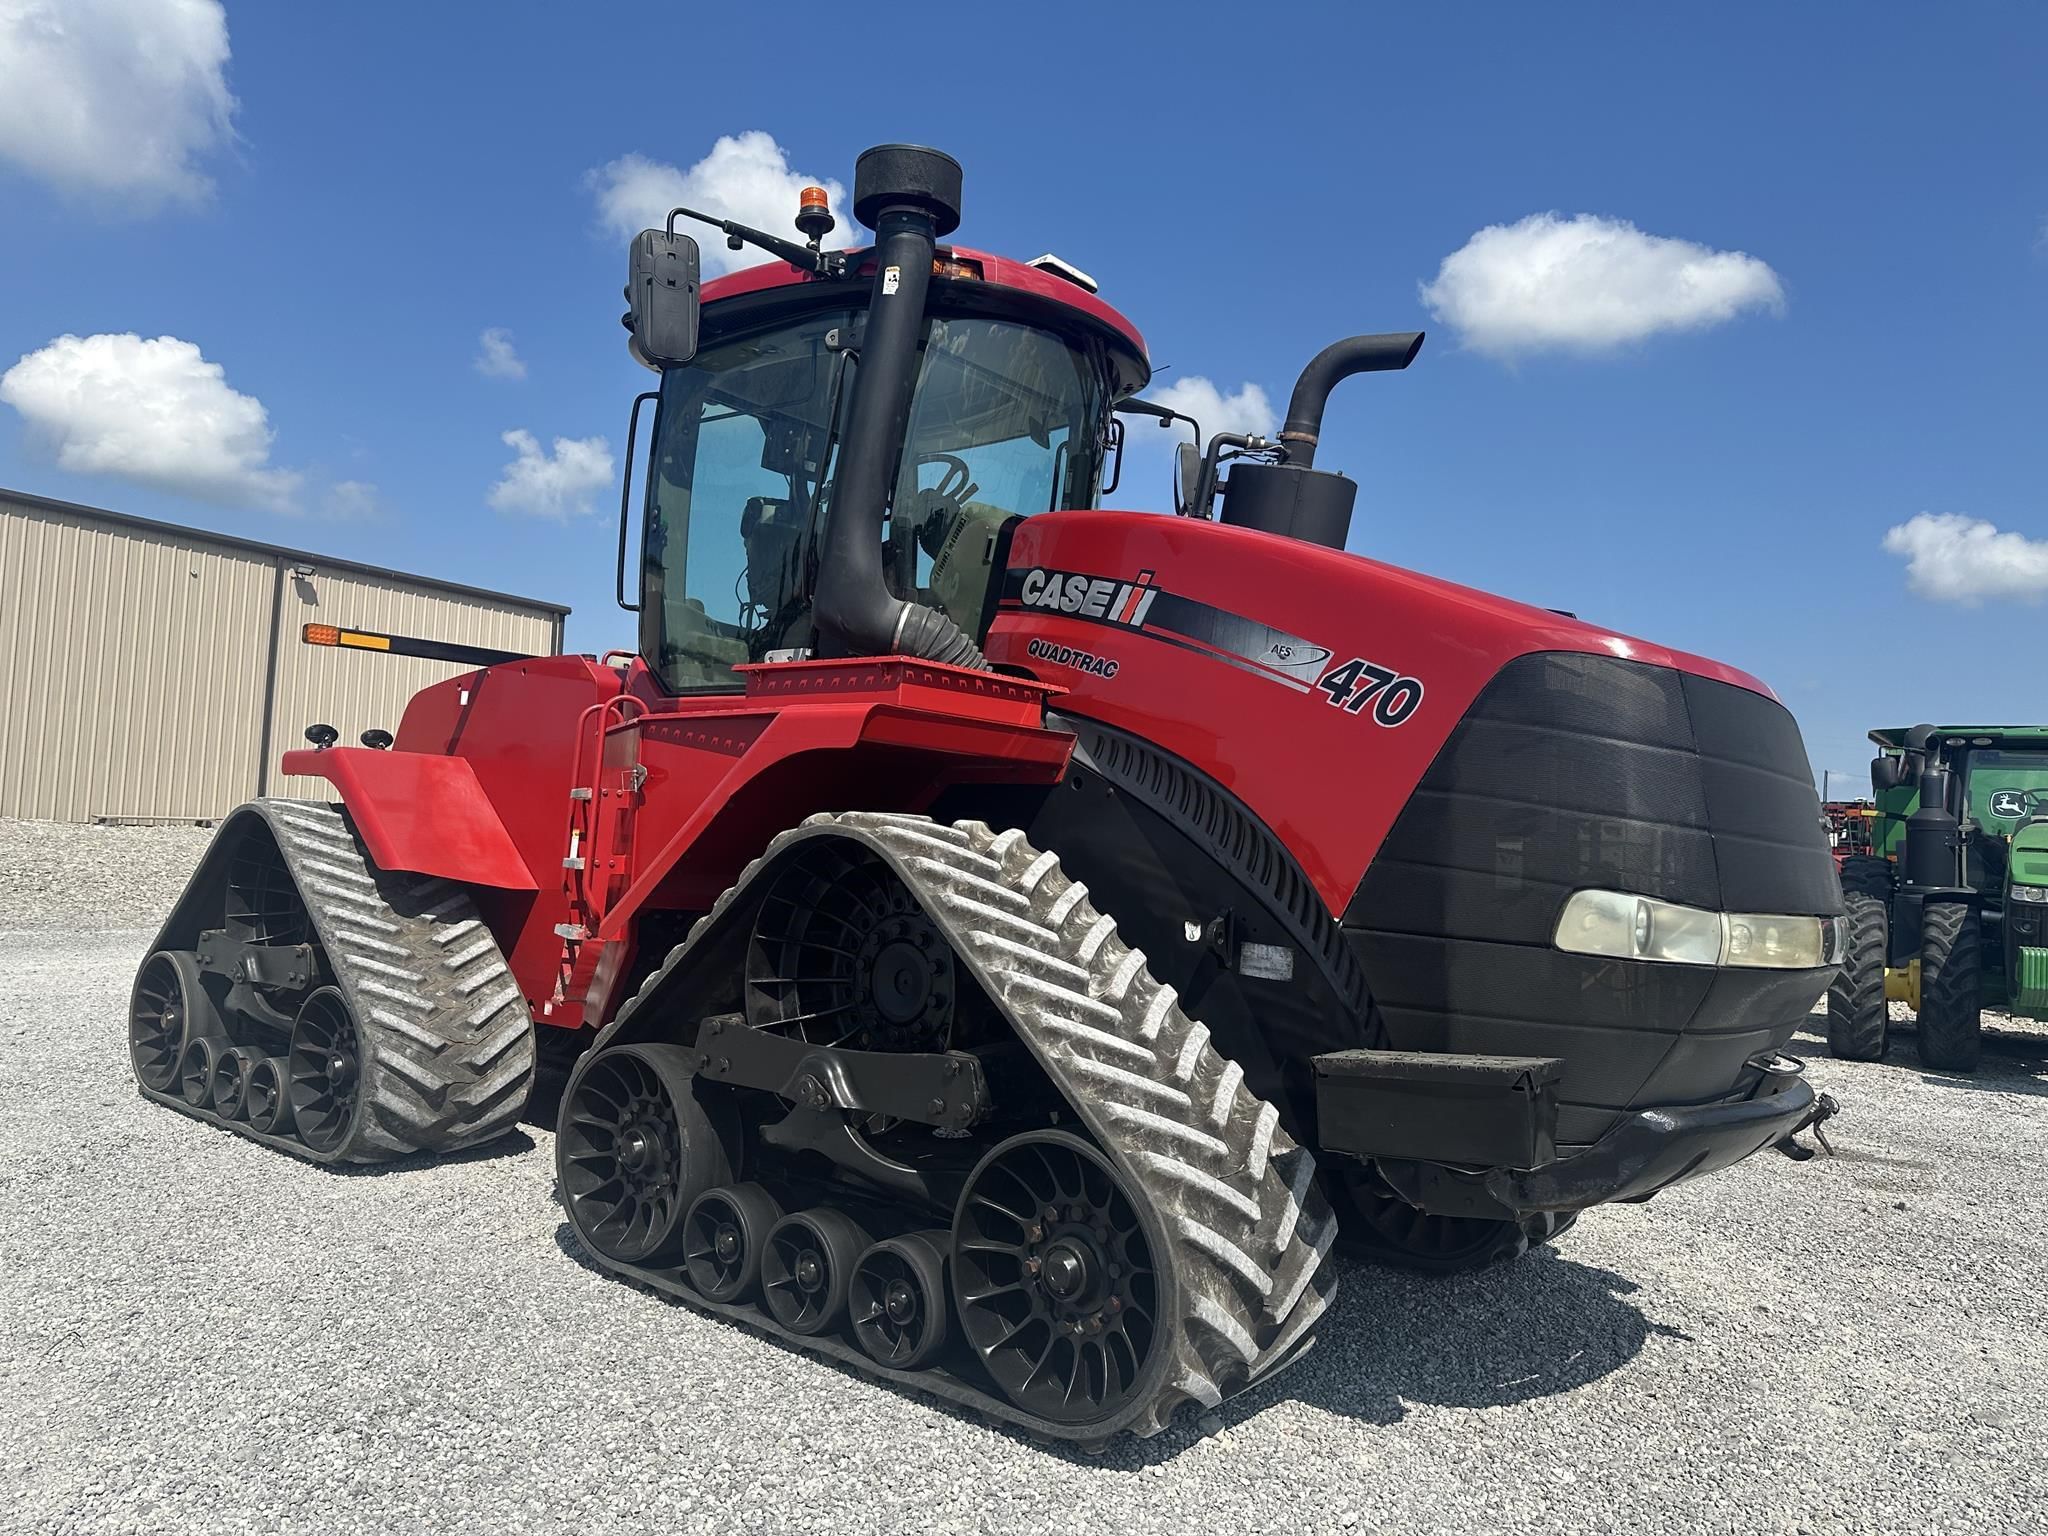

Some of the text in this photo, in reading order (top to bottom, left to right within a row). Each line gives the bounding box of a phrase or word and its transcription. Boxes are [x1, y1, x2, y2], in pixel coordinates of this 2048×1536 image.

[1021, 569, 1116, 618] CASE
[1027, 638, 1120, 679] QUADTRAC
[1317, 658, 1425, 728] 470
